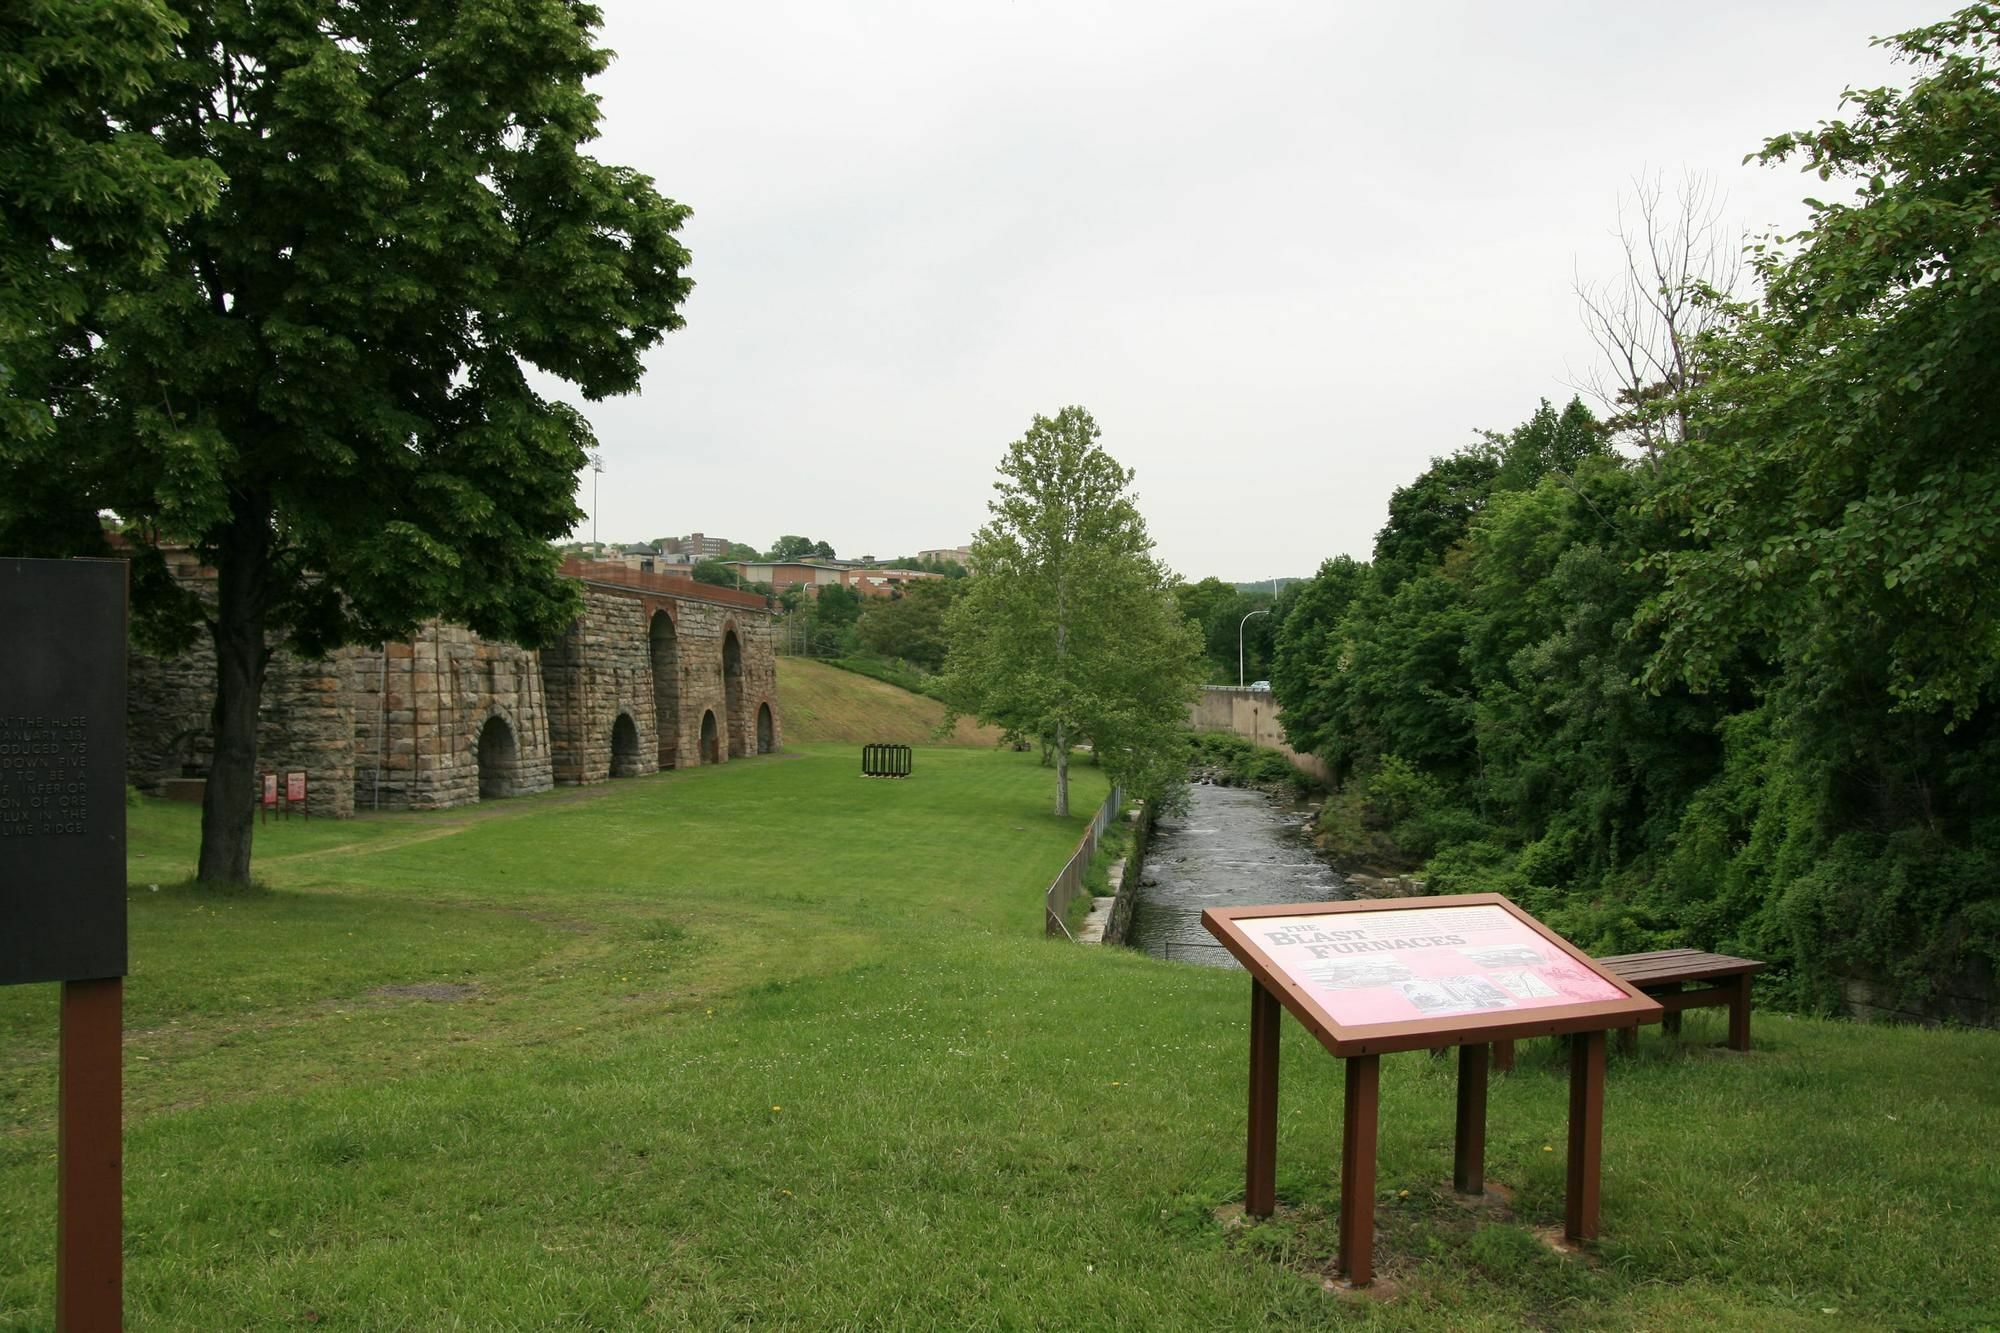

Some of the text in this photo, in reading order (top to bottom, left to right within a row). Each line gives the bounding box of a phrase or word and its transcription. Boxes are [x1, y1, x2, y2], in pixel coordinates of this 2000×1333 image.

[17, 717, 44, 727] THE
[51, 716, 88, 727] HUGE
[71, 742, 88, 753] 75
[2, 756, 87, 769] DOWN FIVE
[16, 770, 36, 781] TO
[48, 769, 65, 781] BE
[23, 782, 88, 794] INFERIOR
[31, 796, 49, 808] OF
[59, 795, 88, 806] ORE
[39, 809, 52, 820] IN
[61, 808, 87, 819] THE
[2, 822, 88, 836] LIME RIDGE.
[1280, 924, 1318, 933] THE
[1264, 929, 1367, 946] BLAST
[1303, 934, 1468, 960] FURNACES
